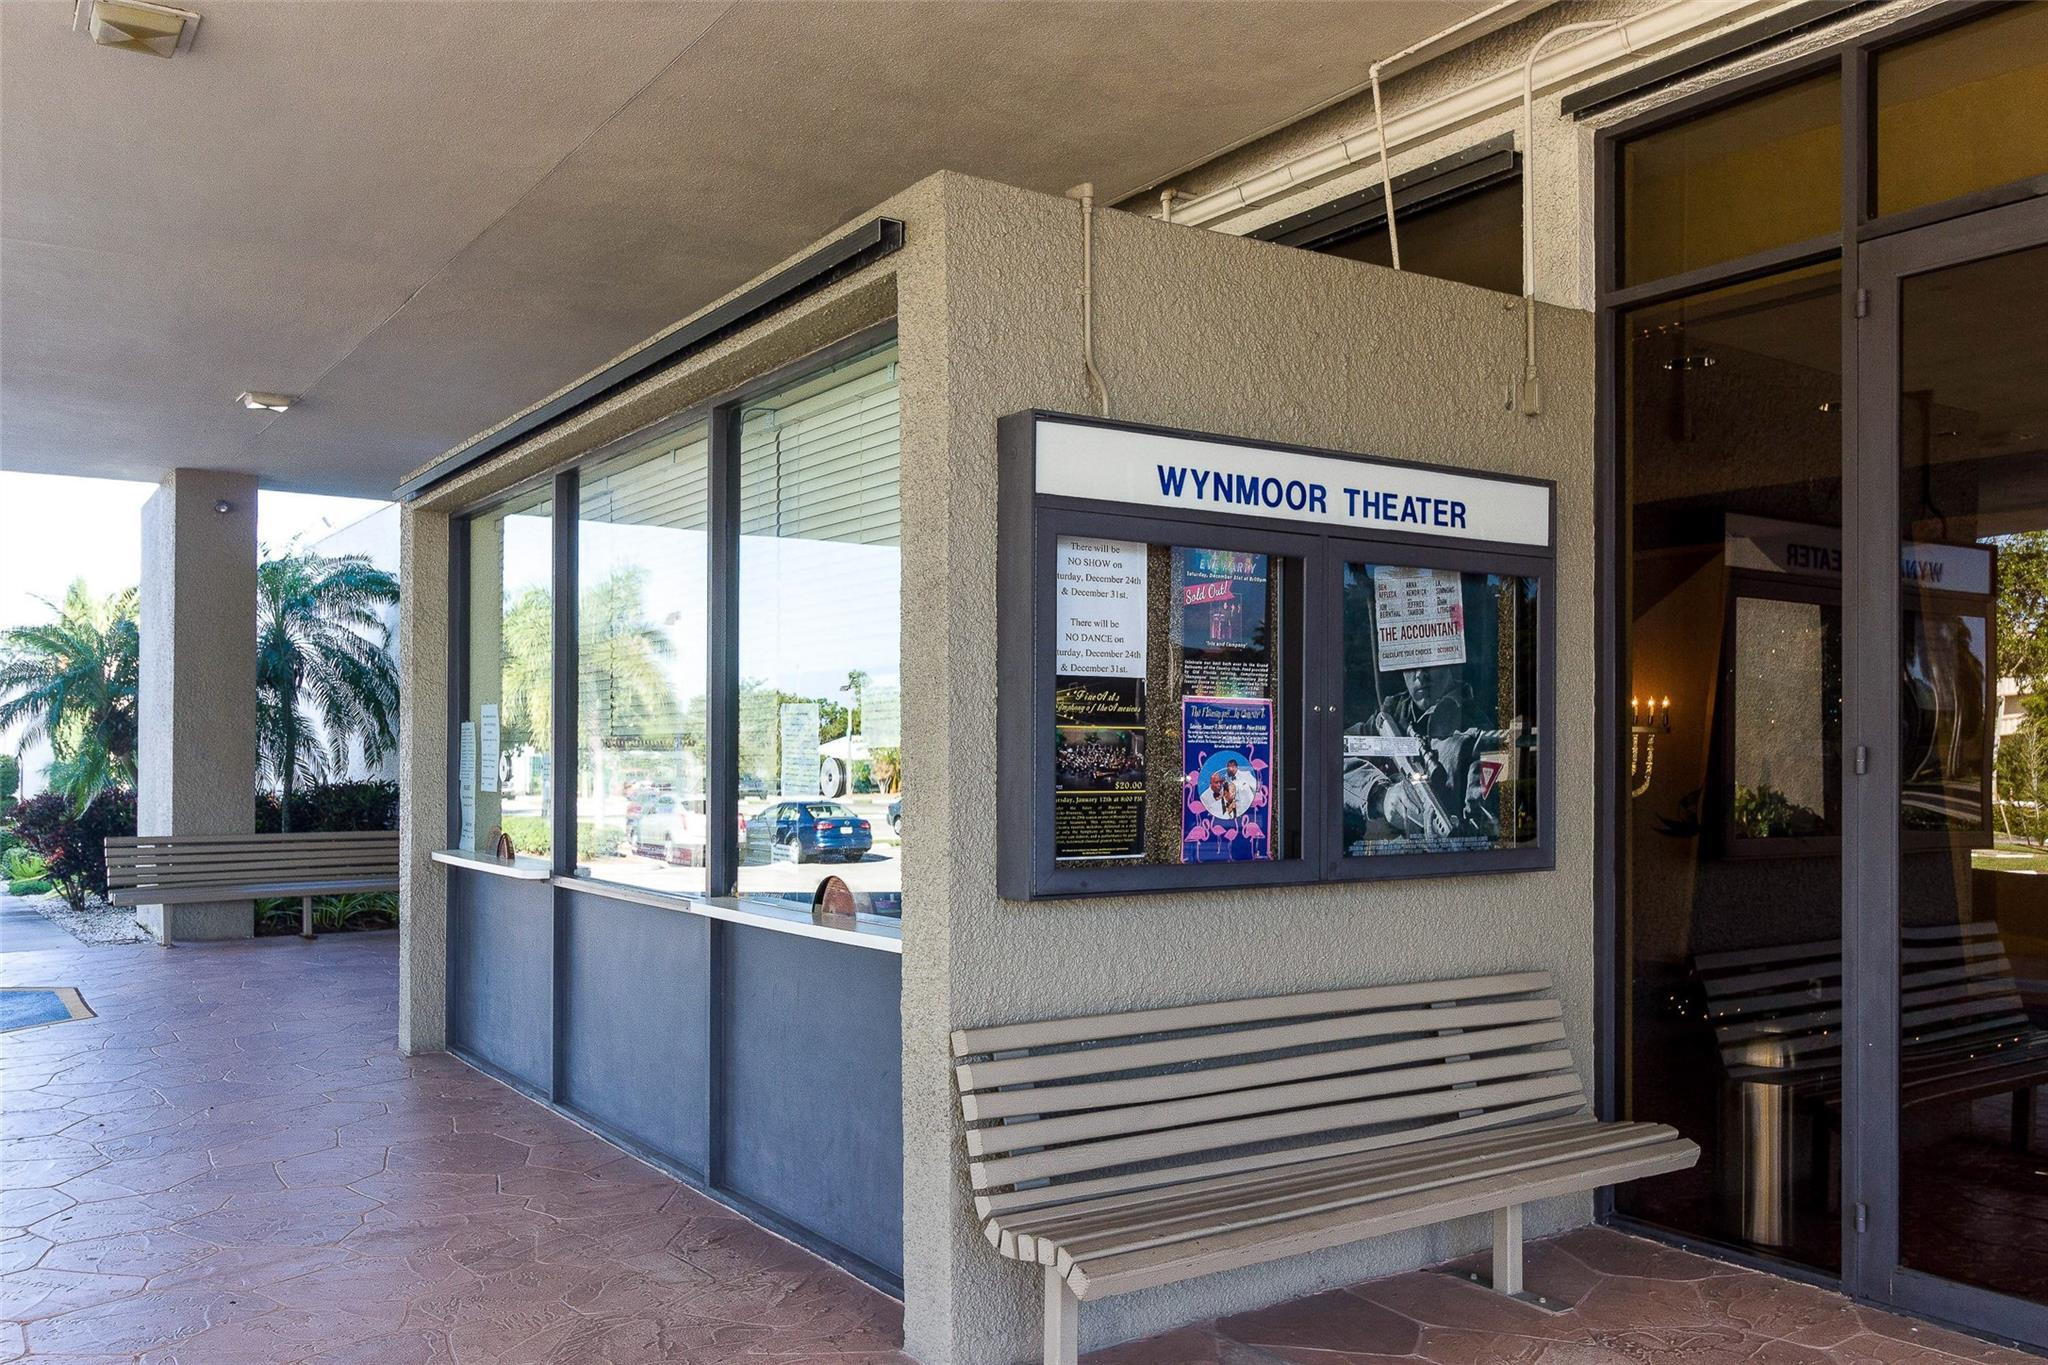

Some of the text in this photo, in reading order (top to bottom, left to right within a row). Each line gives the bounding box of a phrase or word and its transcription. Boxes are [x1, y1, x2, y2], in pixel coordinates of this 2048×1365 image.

[1157, 465, 1466, 528] WYNMOOR THEATER
[1071, 542, 1092, 552] There
[1095, 545, 1108, 553] will
[1068, 557, 1081, 566] NO
[1084, 559, 1110, 567] SHOW
[1222, 560, 1256, 573] PARTY
[1086, 574, 1123, 583] December
[1125, 576, 1141, 584] 24th
[1062, 587, 1128, 599] & December 31st.
[1186, 581, 1228, 604] Sold Out!
[1071, 618, 1119, 628] There will be
[1380, 622, 1458, 641] THE ACCOUNTANT
[1066, 633, 1079, 641] NO
[1082, 634, 1112, 642] DANCE
[1086, 649, 1123, 658] December
[1125, 650, 1141, 658] 24th
[1071, 664, 1108, 673] December
[1110, 665, 1128, 673] 31st.
[1076, 690, 1119, 701] Fine Arts
[1097, 703, 1108, 712] the
[1076, 796, 1097, 804] January
